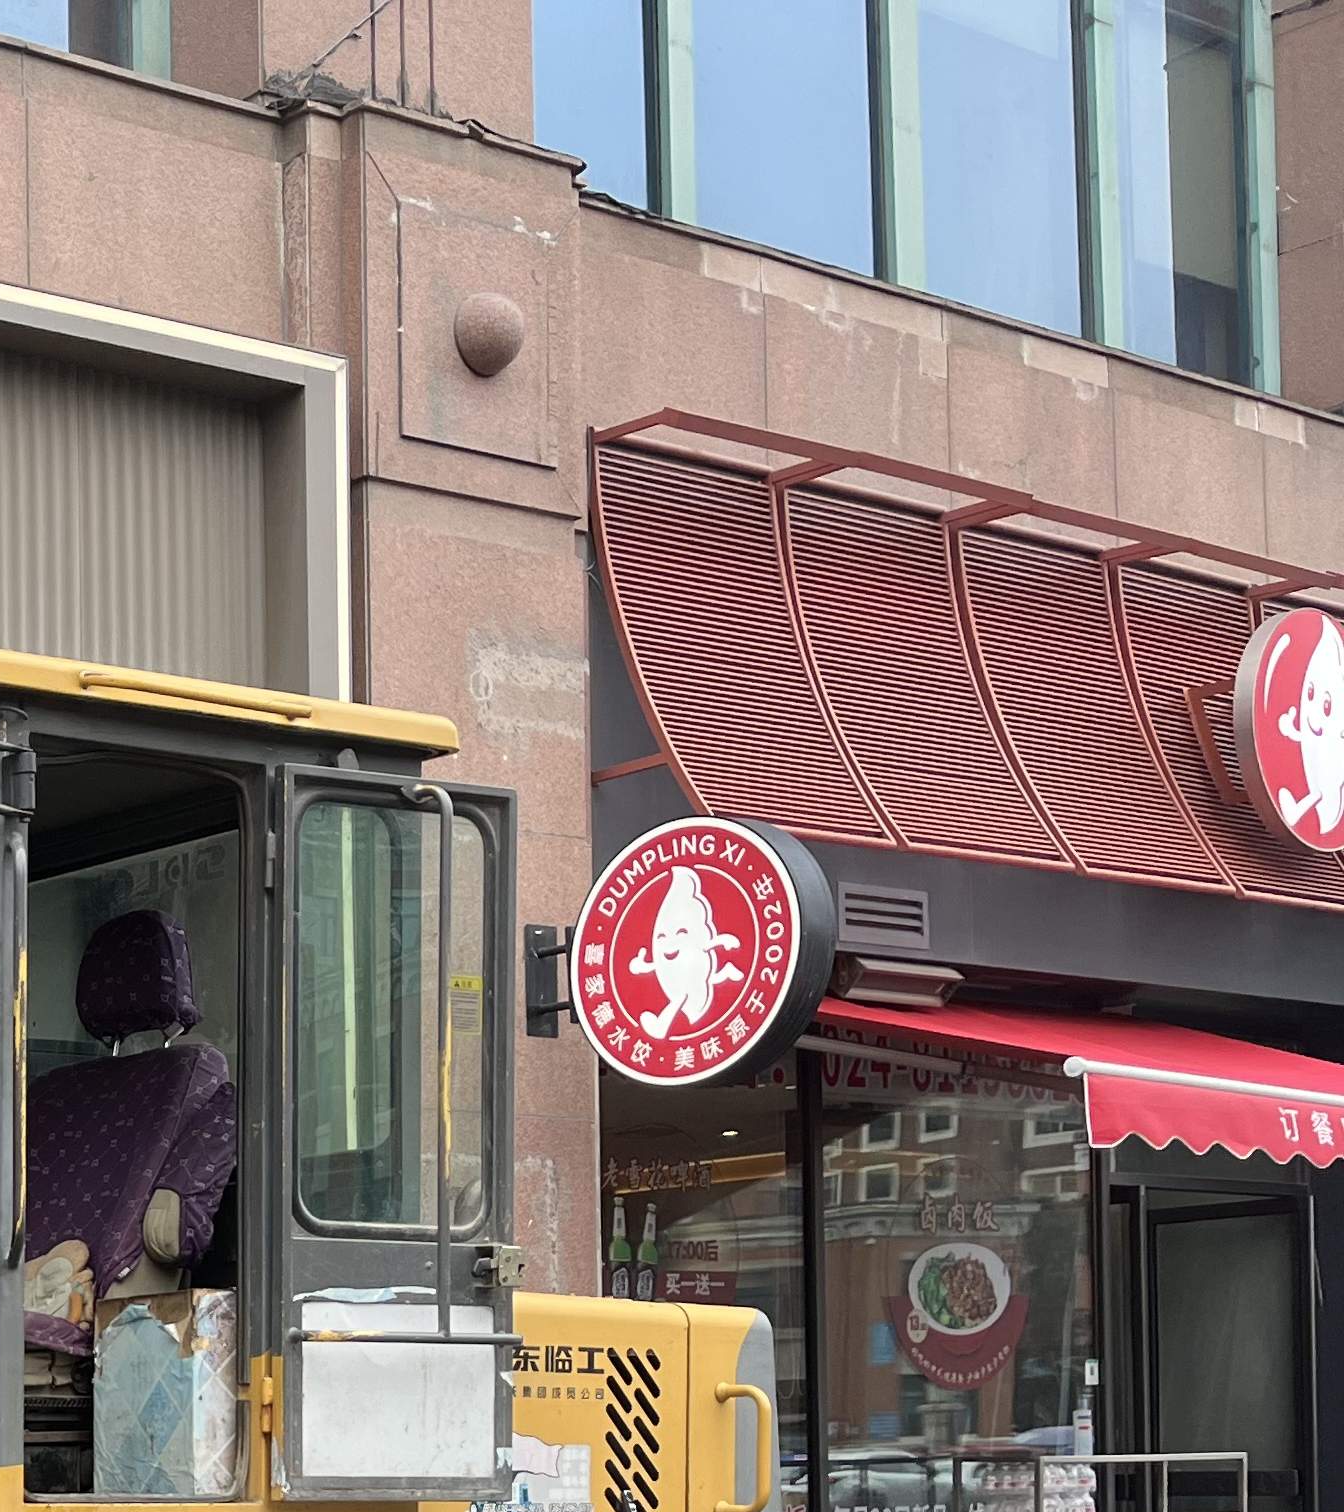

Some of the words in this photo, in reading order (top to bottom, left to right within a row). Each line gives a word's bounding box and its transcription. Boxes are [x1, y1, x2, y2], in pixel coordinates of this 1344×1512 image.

[598, 834, 716, 918] DUMPLING
[719, 839, 746, 867] XI
[583, 942, 653, 1067] 喜家德水饺
[1278, 1107, 1344, 1146] 订餐
[920, 1191, 1000, 1234] 卤肉饭
[665, 1272, 725, 1295] 买一送一
